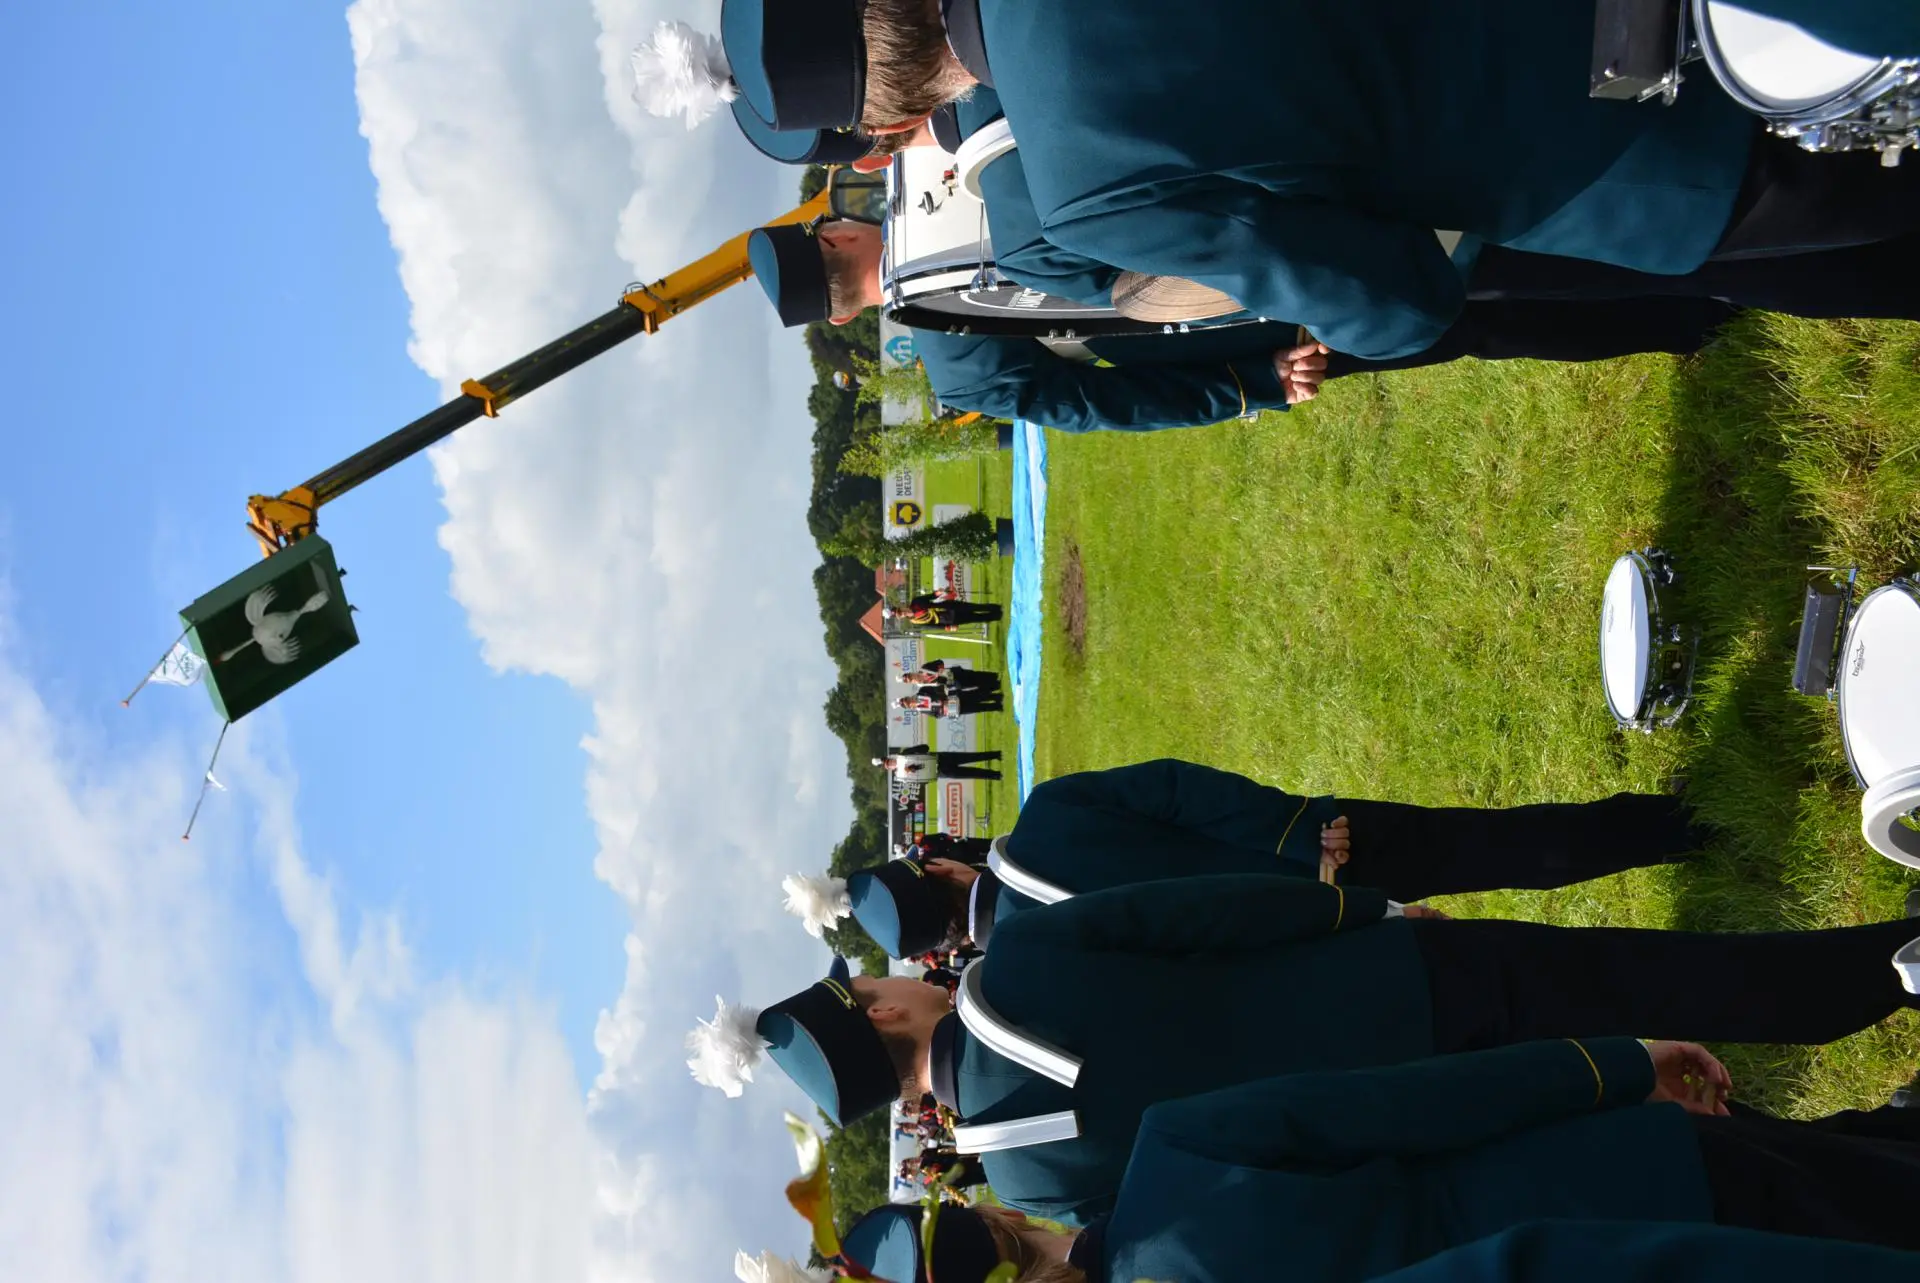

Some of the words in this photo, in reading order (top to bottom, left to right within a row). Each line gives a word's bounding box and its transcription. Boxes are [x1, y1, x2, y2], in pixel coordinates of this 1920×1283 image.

[908, 640, 917, 662] dam
[901, 656, 911, 672] ten
[910, 782, 921, 800] FEE
